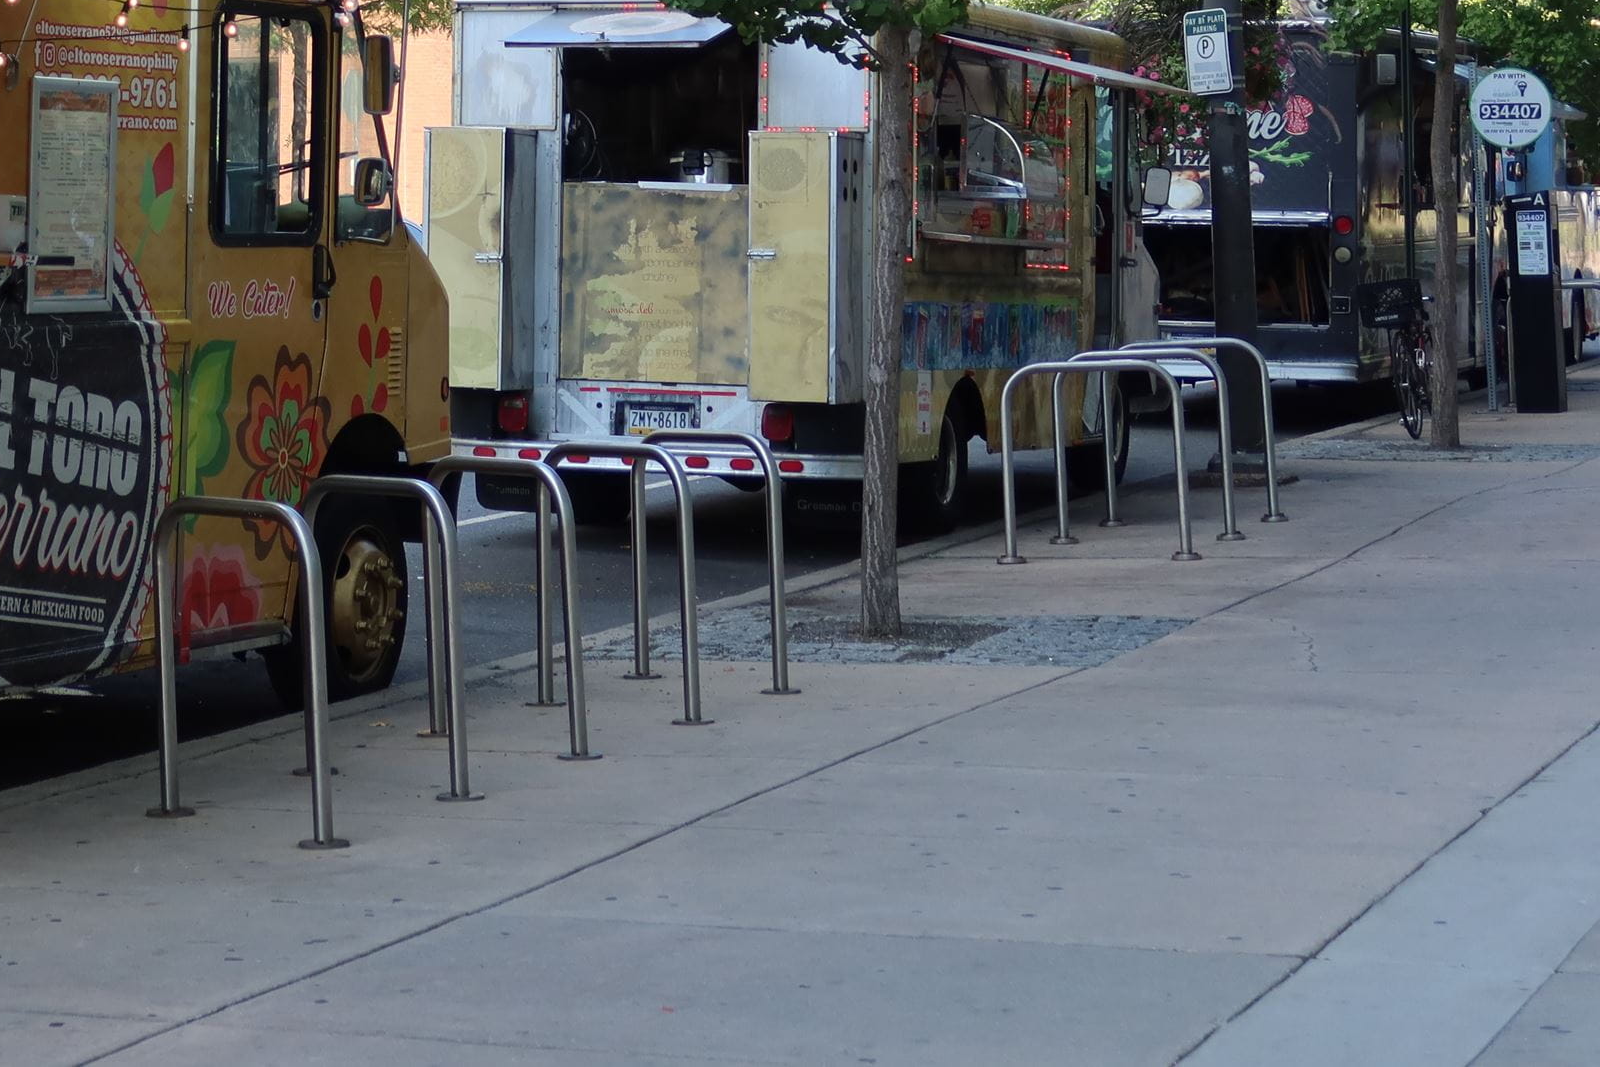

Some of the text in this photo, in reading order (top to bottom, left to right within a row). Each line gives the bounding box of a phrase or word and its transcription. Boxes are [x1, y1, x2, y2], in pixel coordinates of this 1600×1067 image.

[1208, 14, 1225, 23] PLATE
[1192, 24, 1217, 34] PARKING
[1202, 39, 1209, 55] P
[58, 46, 178, 74] @eltoroserranophilly
[1480, 104, 1540, 119] 934407
[1533, 193, 1545, 206] A
[1517, 214, 1544, 222] 934407
[208, 276, 296, 319] We Cater!
[27, 377, 143, 497] TORO
[22, 601, 31, 615] &
[31, 598, 79, 622] MEXICAN
[78, 605, 105, 623] FOOD
